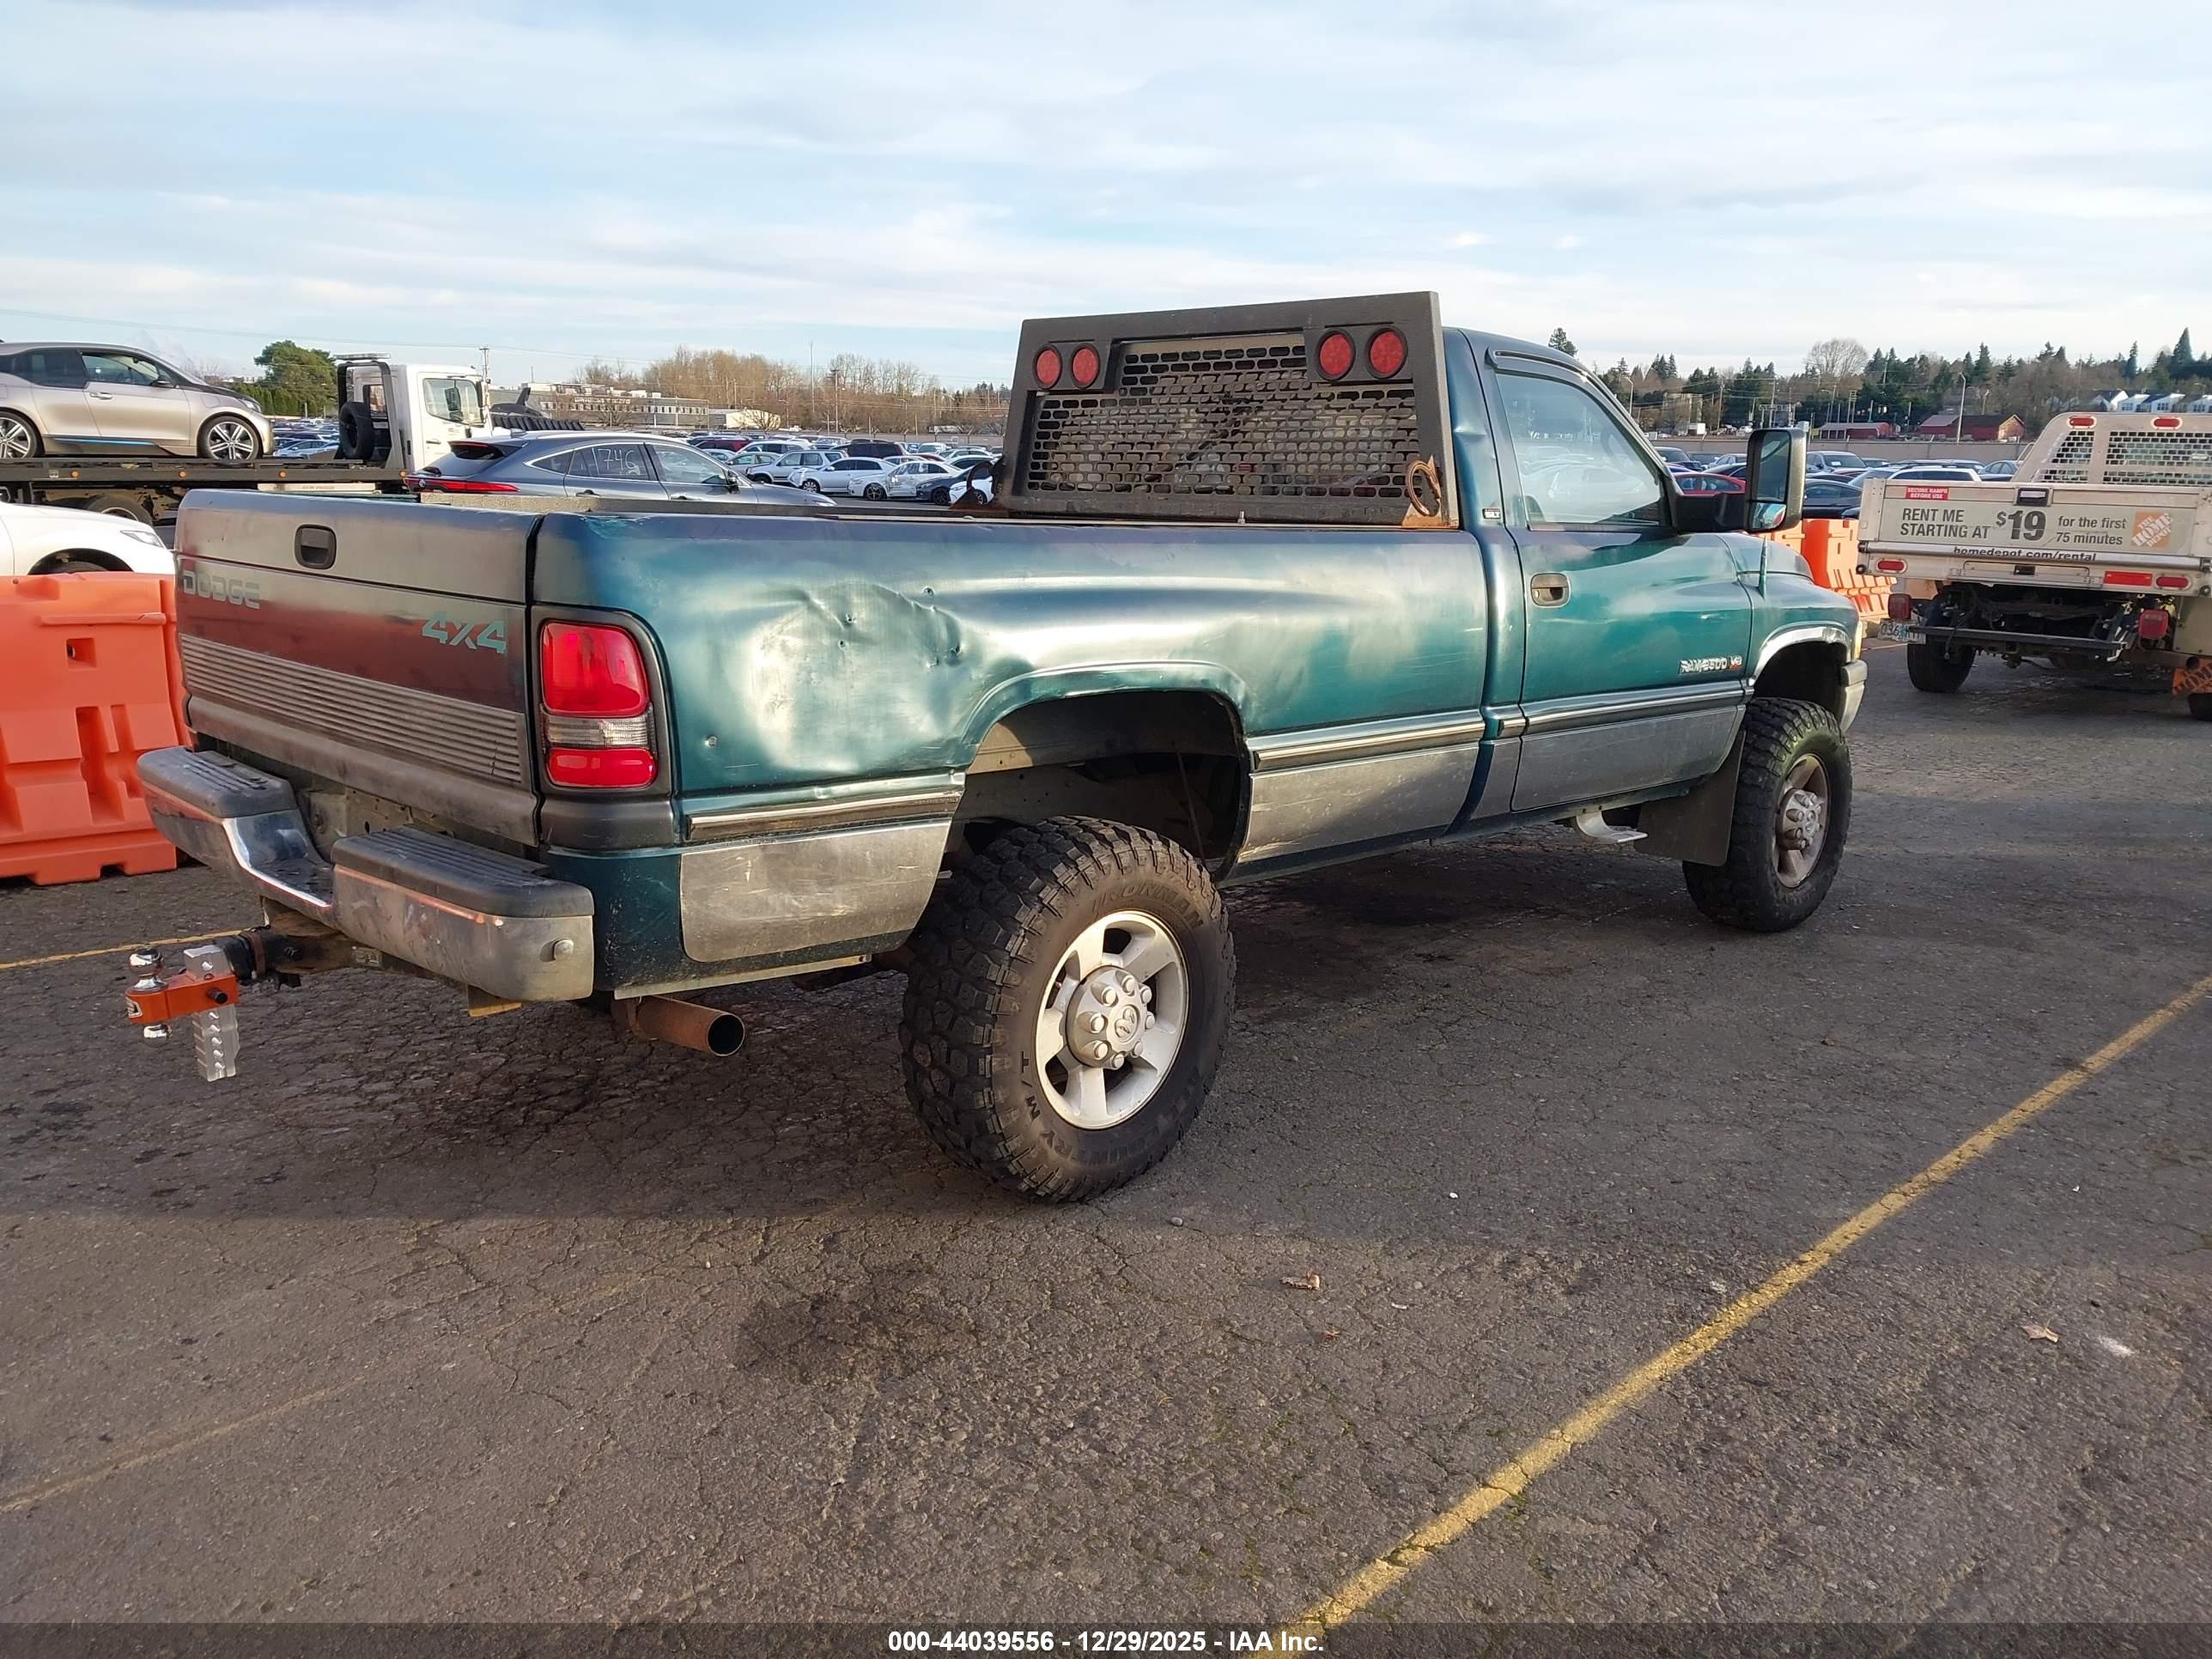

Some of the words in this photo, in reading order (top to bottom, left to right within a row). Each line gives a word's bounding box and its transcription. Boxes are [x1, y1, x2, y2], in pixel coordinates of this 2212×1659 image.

[1902, 507, 1938, 522] RENT
[1942, 509, 1965, 523] ME
[2058, 515, 2075, 527] for
[2078, 516, 2098, 528] the
[2101, 517, 2128, 530] first
[1899, 522, 1968, 538] STARTING
[1972, 526, 1991, 539] AT
[1996, 509, 2047, 542] $19
[2056, 532, 2070, 543] 75
[2073, 532, 2124, 546] minutes
[183, 569, 260, 610] DODGE
